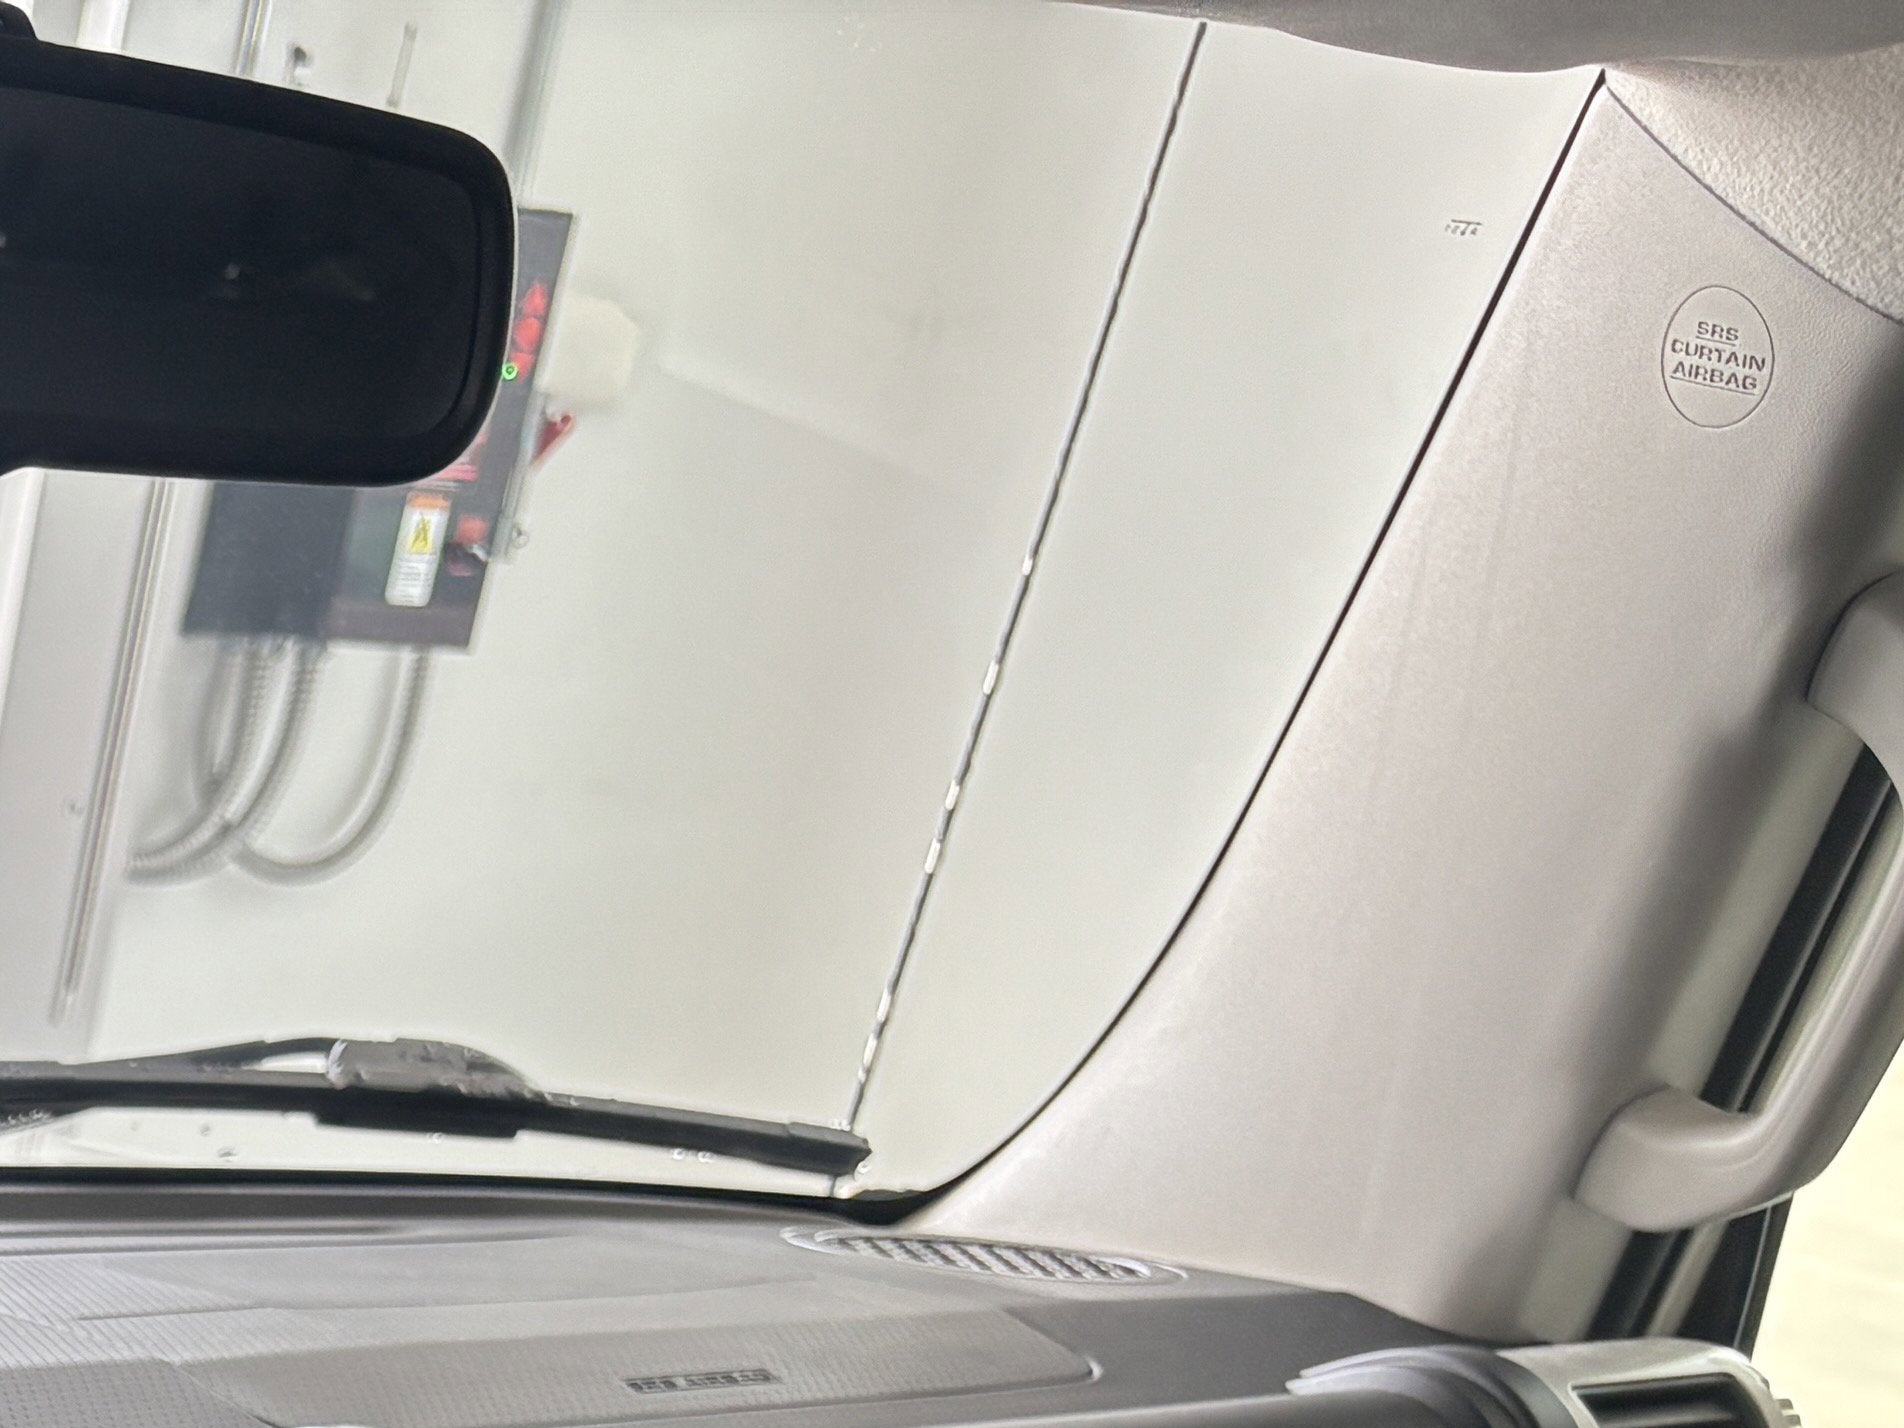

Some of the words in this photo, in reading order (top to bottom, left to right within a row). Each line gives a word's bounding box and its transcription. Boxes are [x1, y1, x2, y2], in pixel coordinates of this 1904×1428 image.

[1697, 321, 1739, 341] SRS
[1671, 338, 1766, 372] CURTAIN
[1672, 361, 1757, 390] AIRBAG
